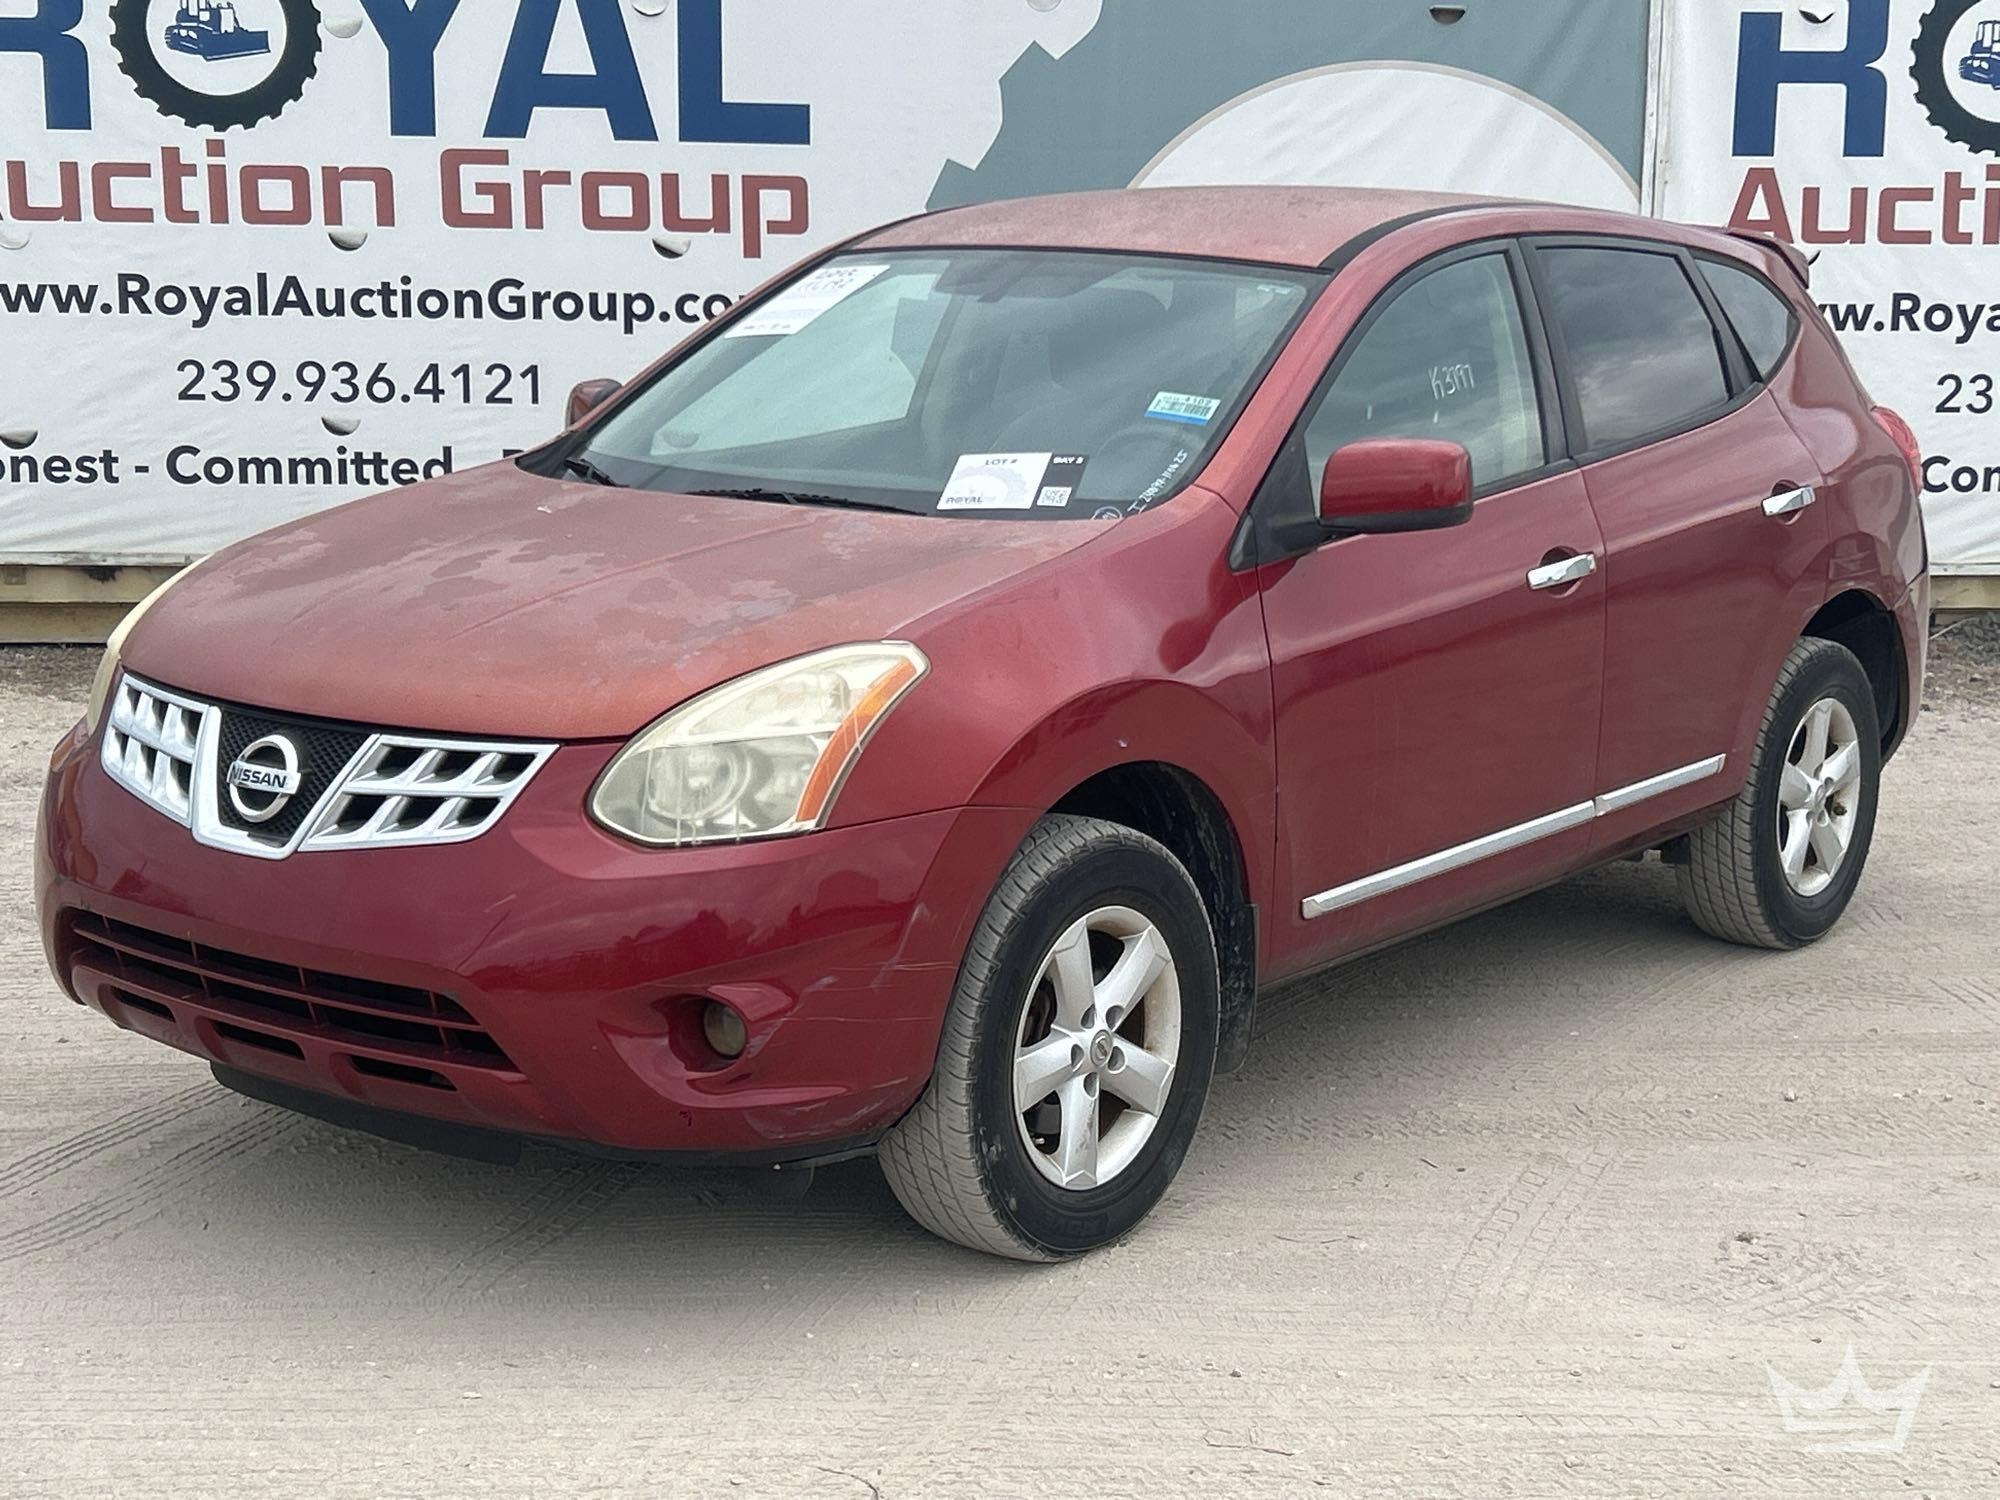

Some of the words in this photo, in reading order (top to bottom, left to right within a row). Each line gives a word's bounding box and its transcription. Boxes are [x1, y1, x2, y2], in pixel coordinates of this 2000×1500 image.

[0, 139, 396, 227] uction
[440, 148, 810, 259] Group
[0, 273, 744, 335] ww.RoyalAuctionGroup.co
[176, 358, 540, 405] 239.936.4121
[0, 449, 120, 485] nest
[134, 465, 150, 473] -
[166, 444, 453, 486] Committed
[985, 458, 1008, 466] LOT
[229, 764, 288, 788] NISSAN
